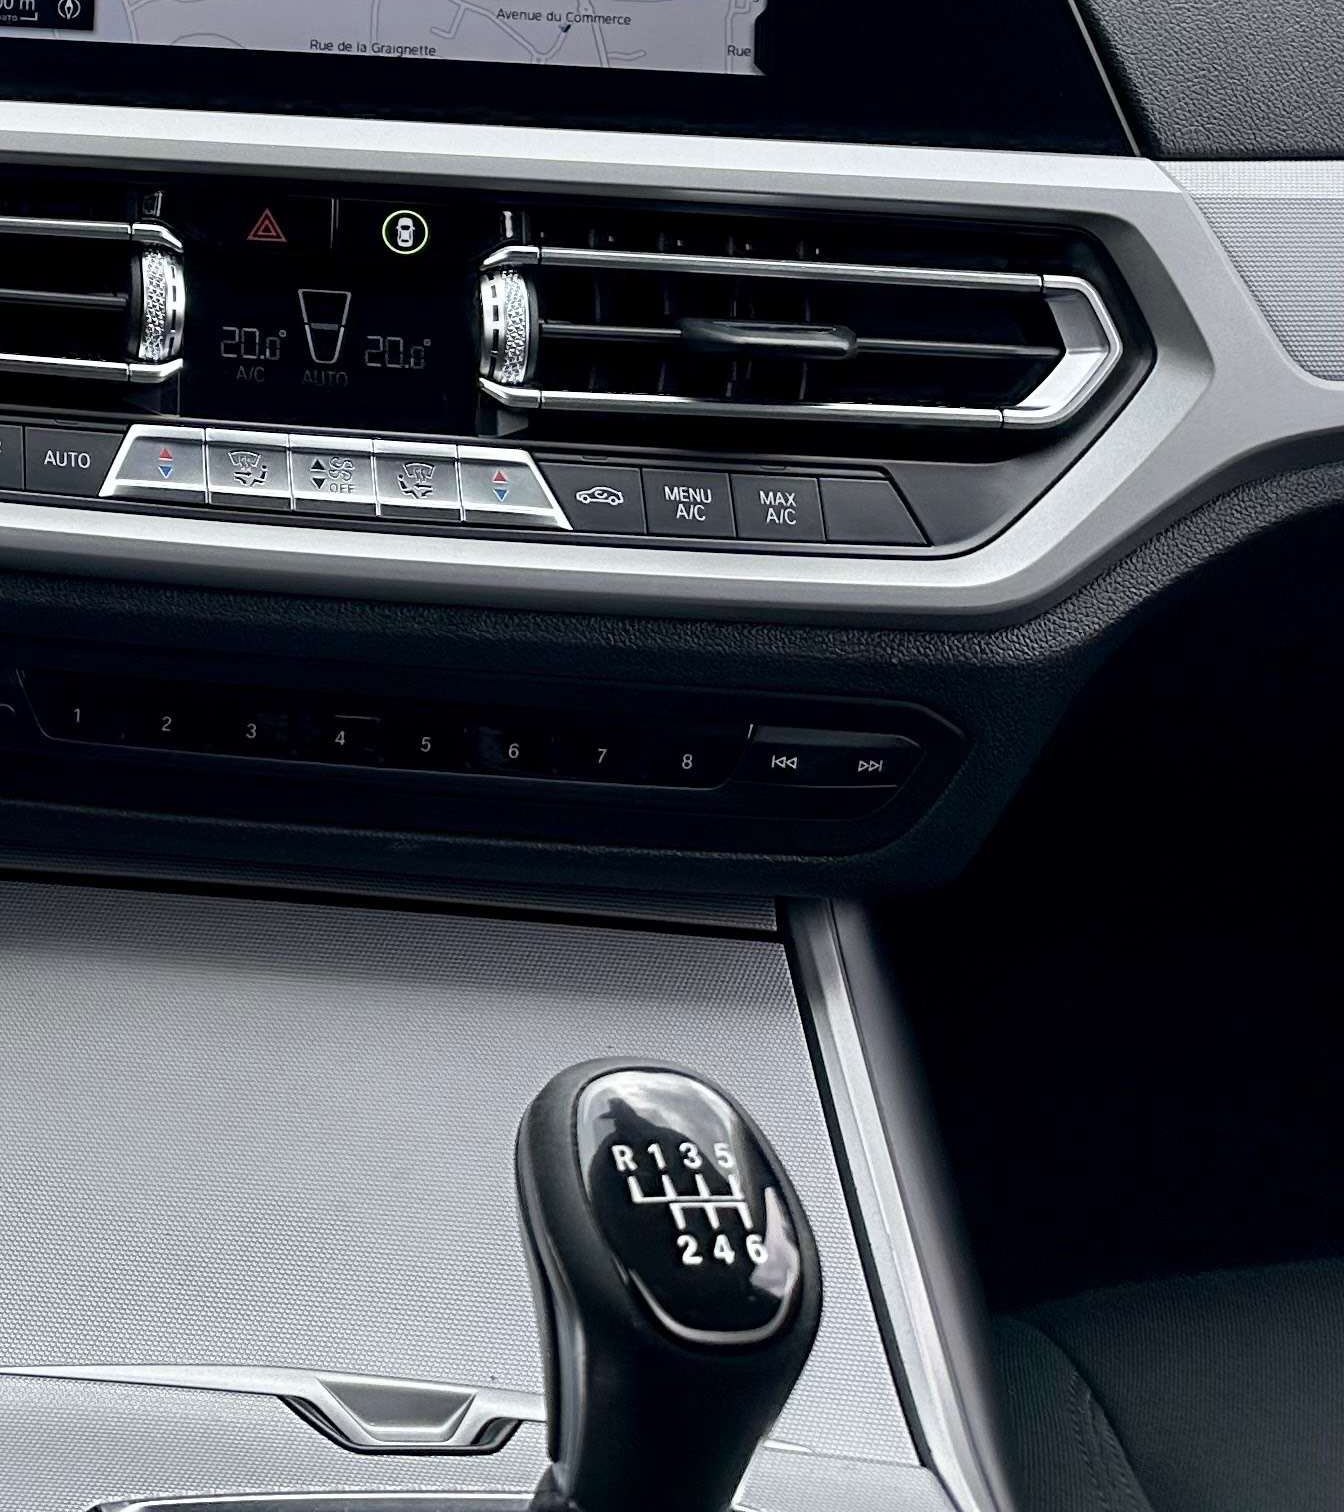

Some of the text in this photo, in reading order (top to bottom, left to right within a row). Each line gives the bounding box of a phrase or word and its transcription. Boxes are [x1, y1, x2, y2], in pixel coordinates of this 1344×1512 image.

[496, 8, 632, 26] Avenue du Commerce
[309, 39, 437, 57] Rue de la Graignette
[727, 45, 752, 57] Rue
[236, 365, 265, 383] A/C
[302, 369, 349, 387] AUTO
[44, 449, 91, 469] AUTO
[329, 483, 356, 494] OFF
[664, 486, 712, 503] MENU
[759, 490, 797, 507] MAX
[675, 505, 707, 523] A/C
[765, 508, 797, 526] A/C
[74, 708, 693, 770] 1 2 3 4 5 6 7 8
[612, 1143, 736, 1171] R 1 3 5
[677, 1234, 769, 1265] 2 4 6
